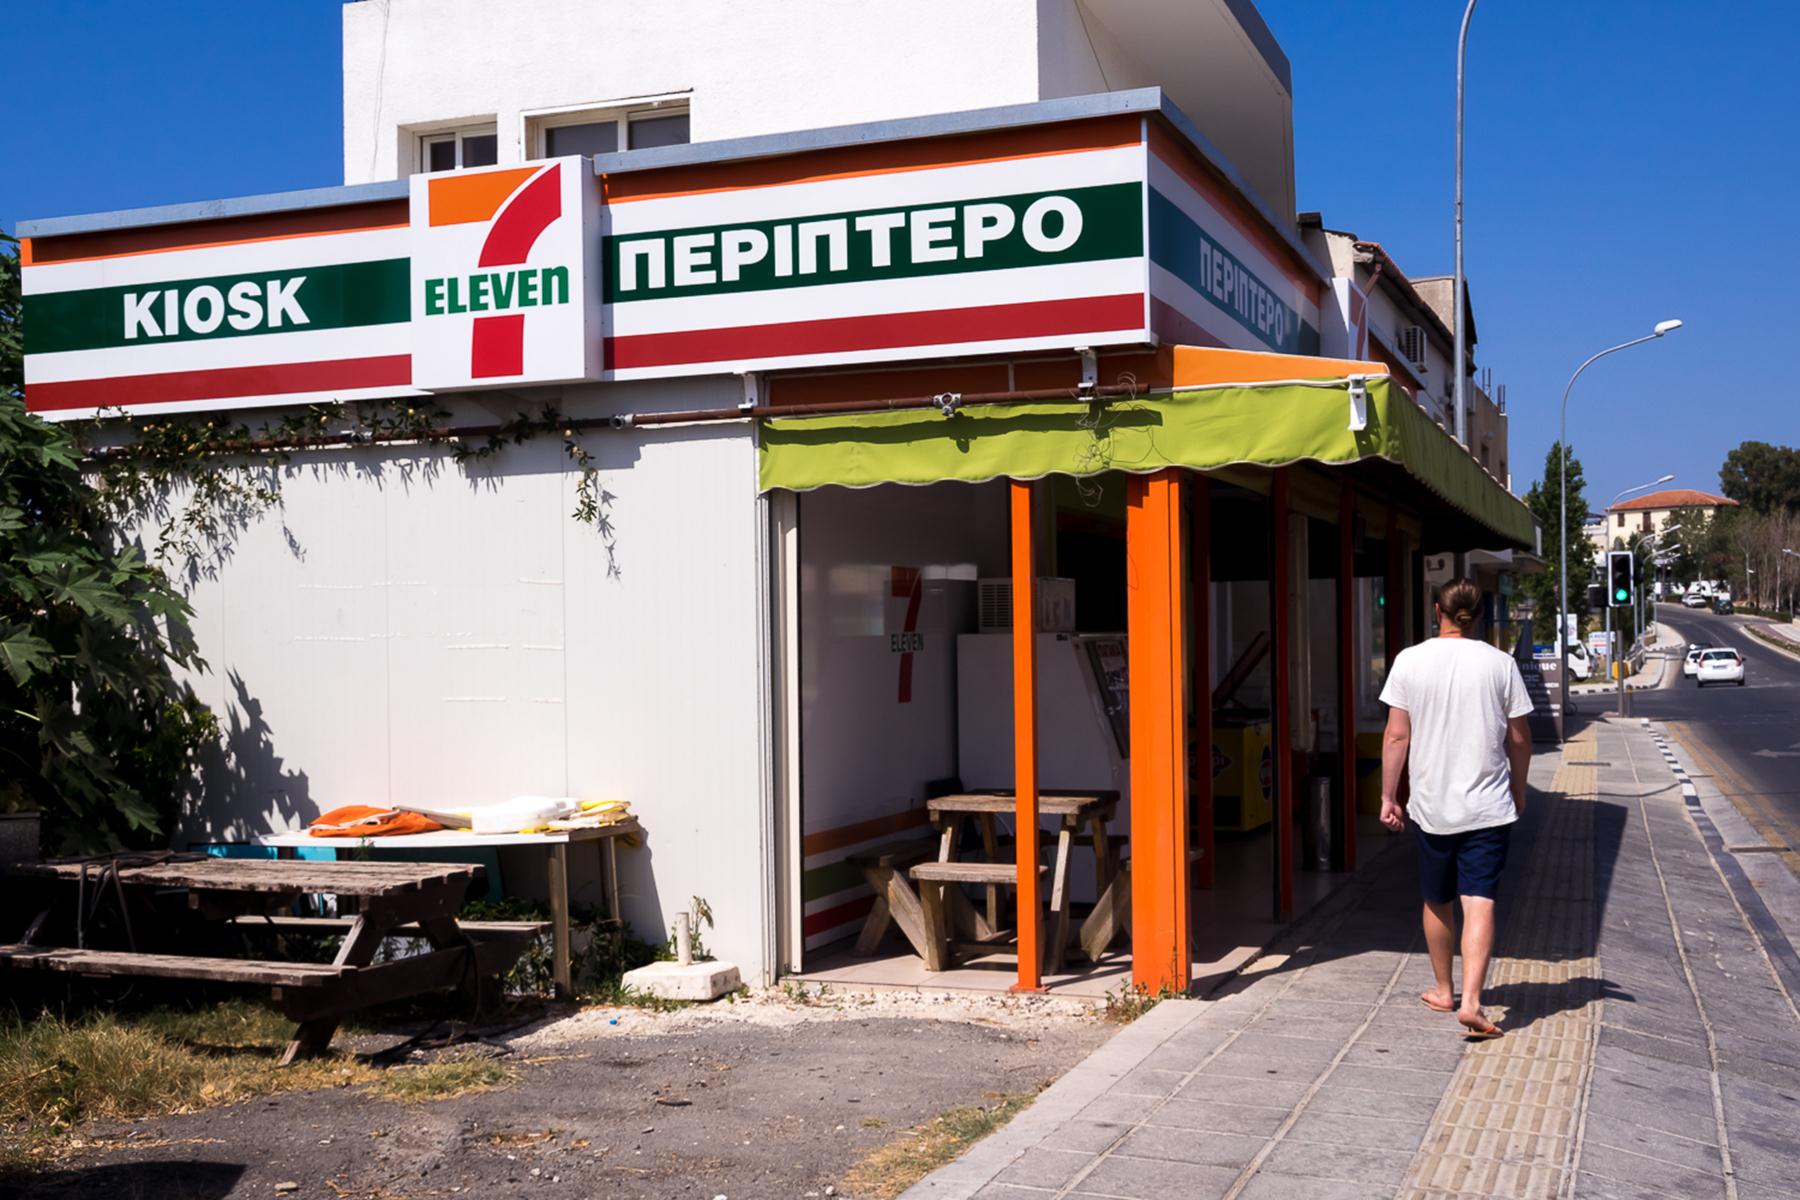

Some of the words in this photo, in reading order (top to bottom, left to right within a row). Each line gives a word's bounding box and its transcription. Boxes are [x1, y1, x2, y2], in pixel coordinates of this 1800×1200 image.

[428, 163, 562, 379] 7
[619, 195, 1083, 292] ΠΕΡΙΠΤΕΡΟ
[1200, 238, 1284, 346] ΠΕΡΙΠΤΕΡΟ
[123, 277, 310, 339] KIOSK
